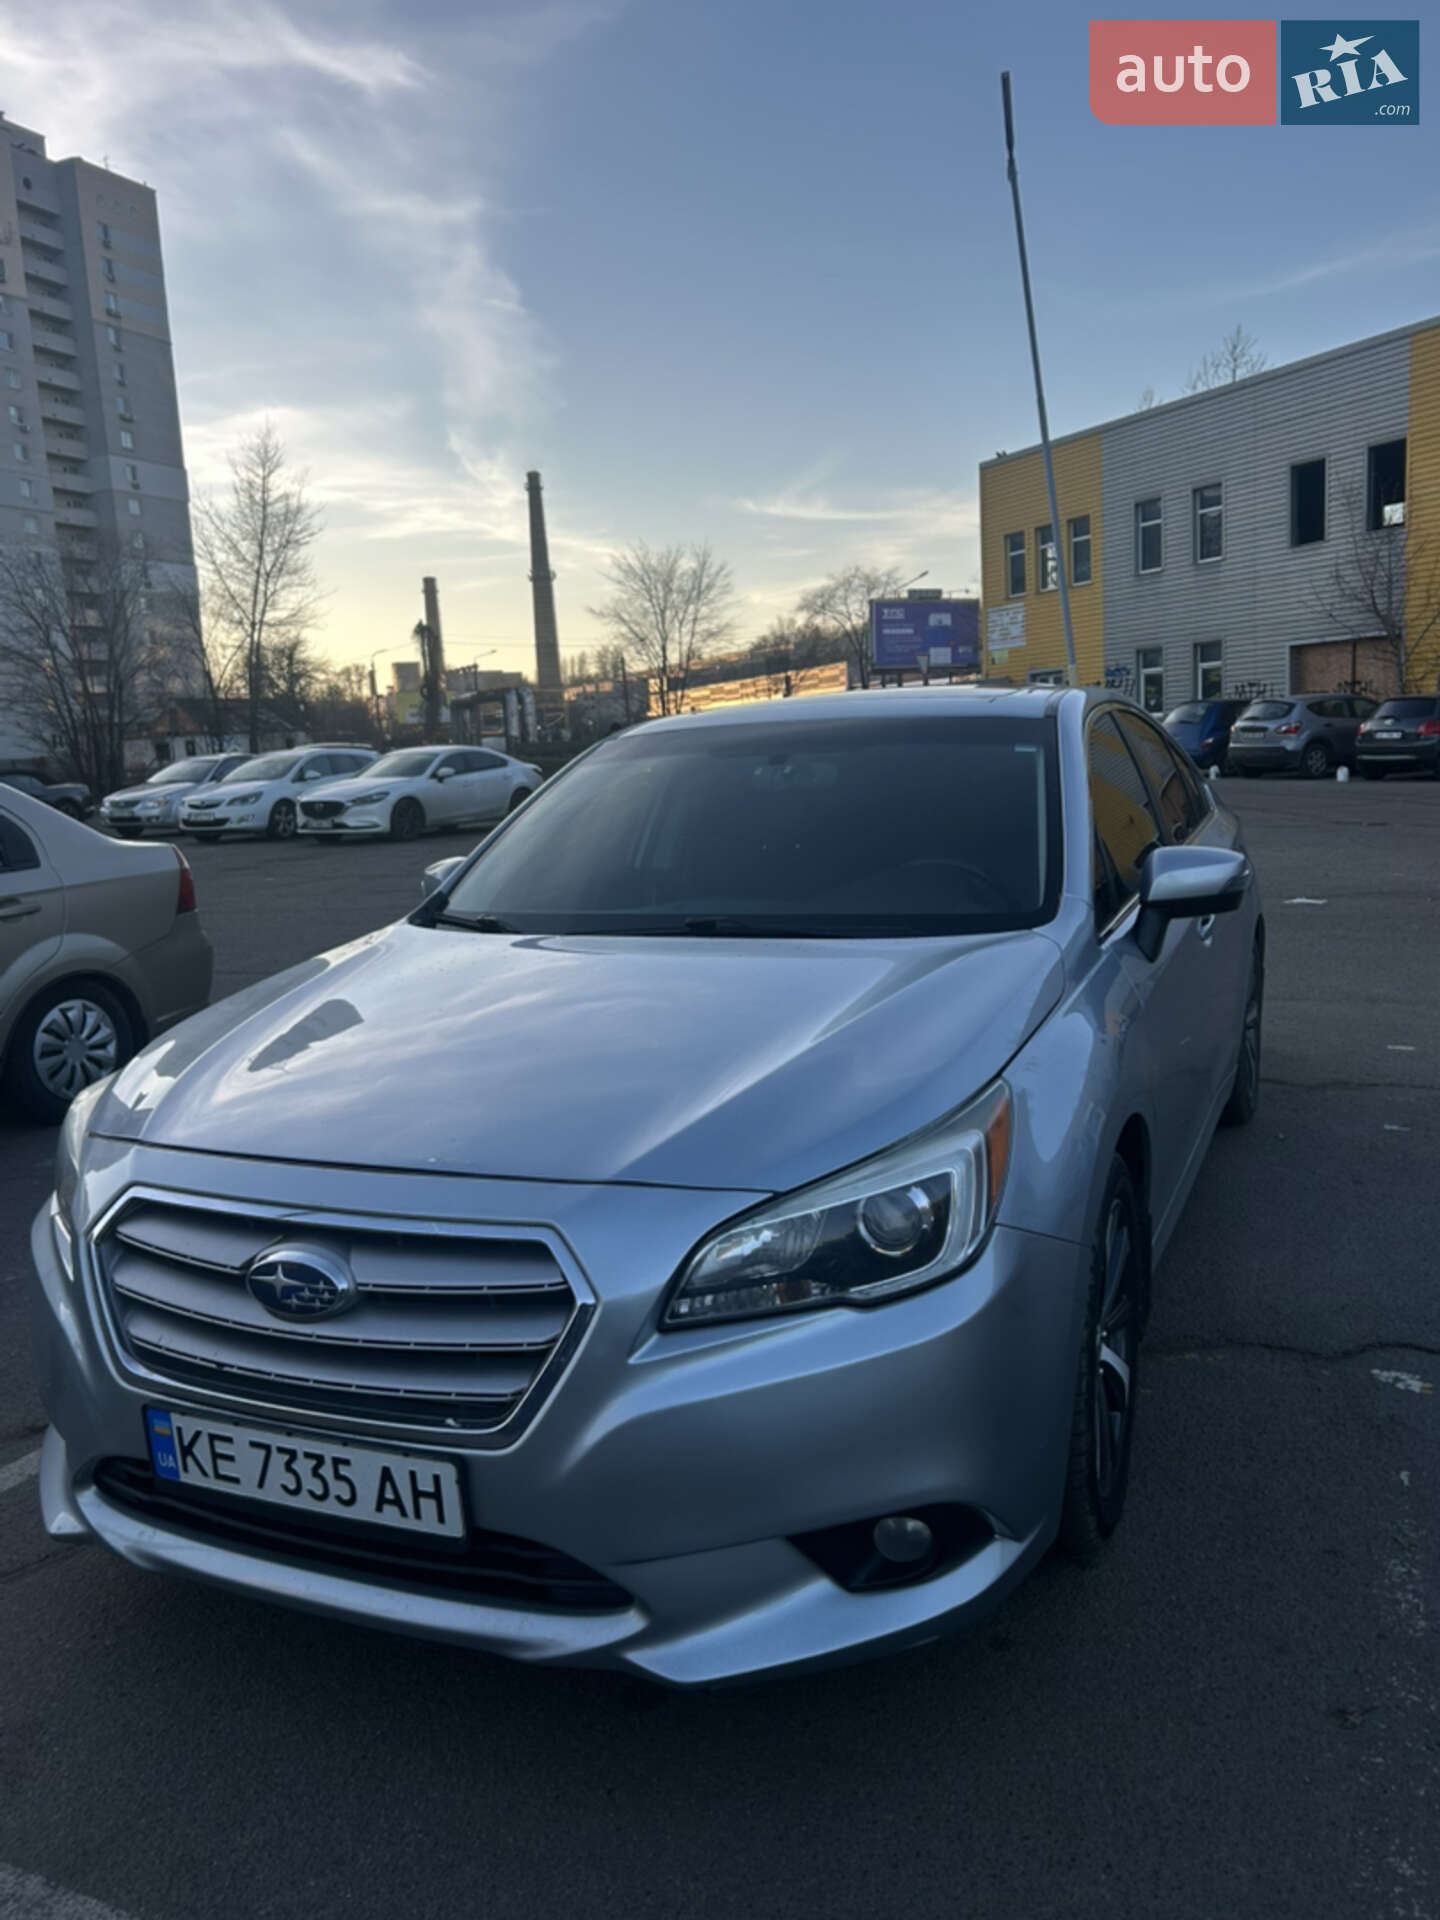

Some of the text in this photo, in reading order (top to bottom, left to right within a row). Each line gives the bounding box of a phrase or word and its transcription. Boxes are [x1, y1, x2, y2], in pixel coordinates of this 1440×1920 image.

[158, 1451, 176, 1469] UA
[175, 1425, 446, 1525] KE 7335 AH
